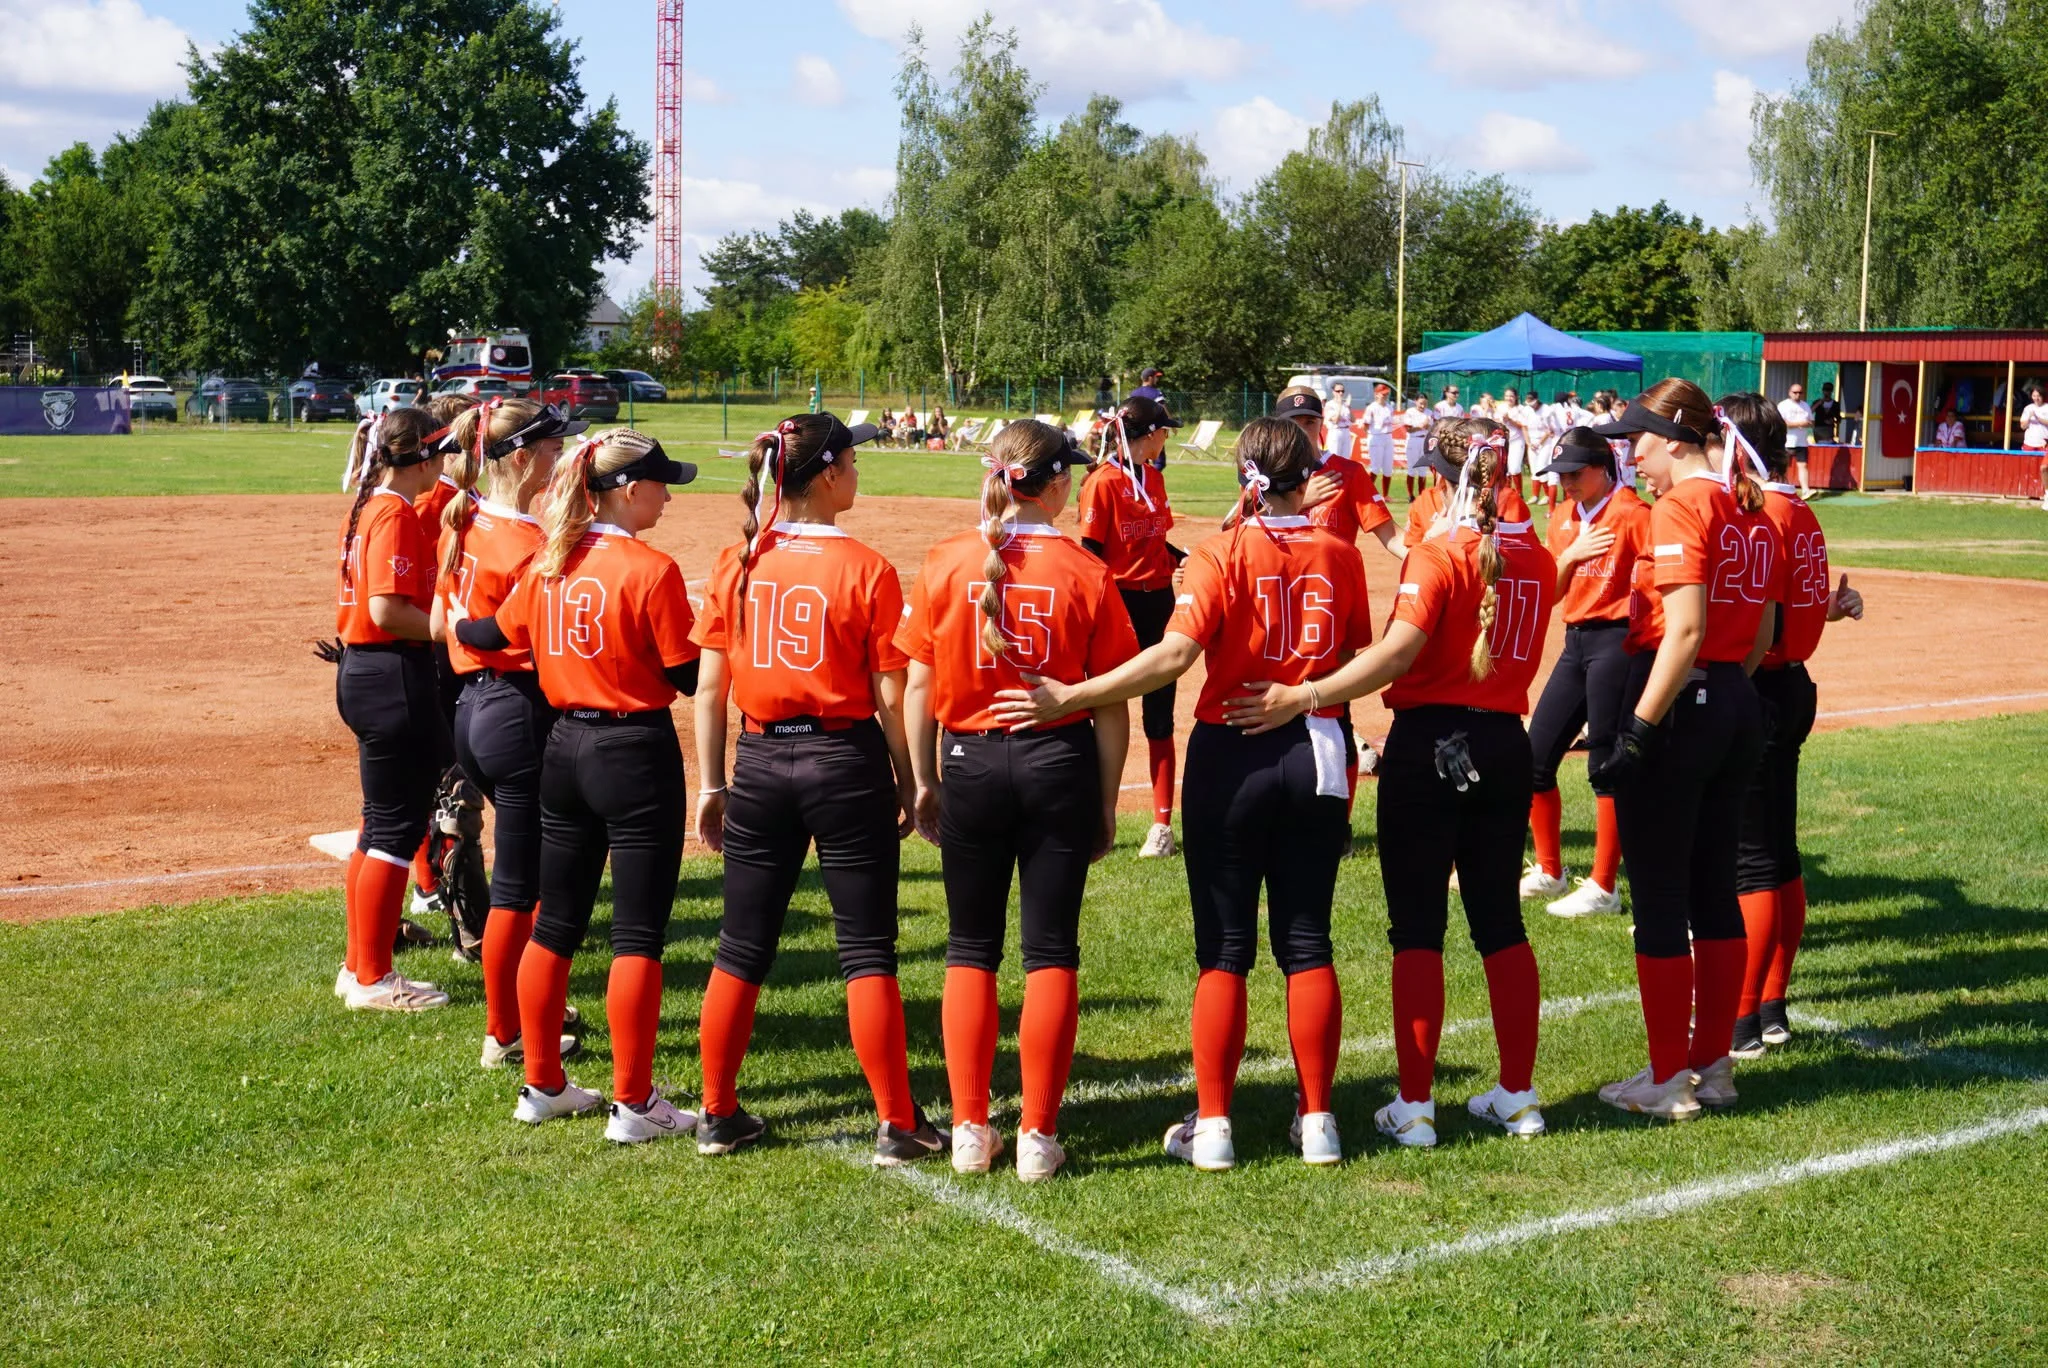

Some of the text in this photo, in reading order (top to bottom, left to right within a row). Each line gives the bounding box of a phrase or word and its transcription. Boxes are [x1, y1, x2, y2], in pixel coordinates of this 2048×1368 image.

[1710, 524, 1775, 604] 20
[1792, 531, 1831, 607] 23
[543, 575, 607, 660] 13
[749, 580, 828, 672] 19
[968, 581, 1056, 671] 15
[1256, 573, 1335, 661] 16
[573, 709, 600, 719] macron
[775, 723, 812, 734] macron
